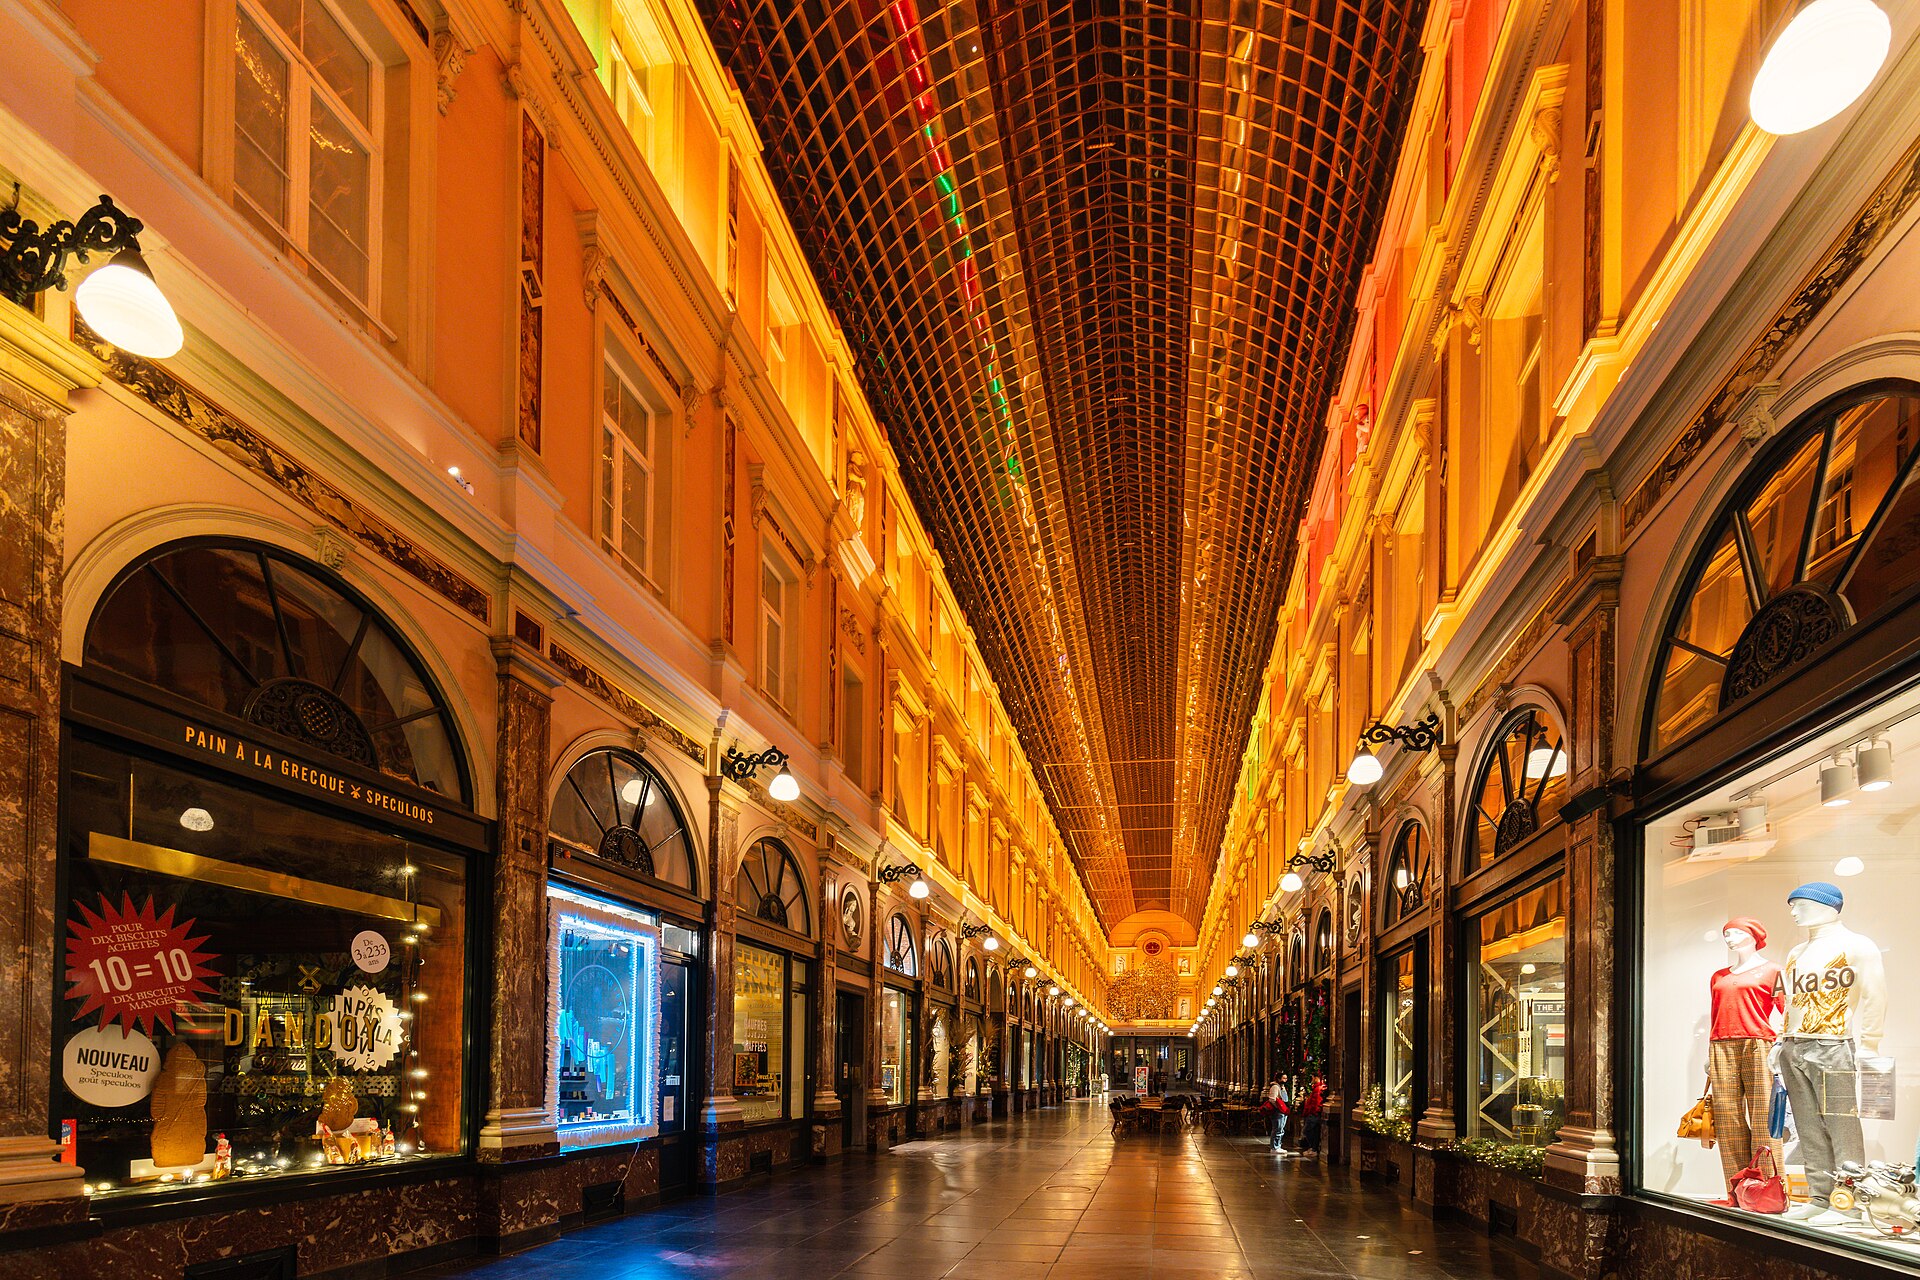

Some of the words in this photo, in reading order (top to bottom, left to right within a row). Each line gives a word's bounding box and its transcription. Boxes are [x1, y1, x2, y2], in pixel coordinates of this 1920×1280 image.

[185, 725, 227, 755] PAIN
[235, 741, 245, 761] À
[254, 750, 273, 770] LA
[281, 759, 346, 795] GRECQUE
[366, 789, 434, 825] SPECULOOS
[111, 922, 144, 934] POUR
[91, 936, 115, 946] DIX
[116, 929, 168, 943] BISCUITS
[363, 939, 374, 947] De
[354, 949, 362, 961] 3
[366, 943, 387, 958] 233
[112, 994, 134, 1005] DIX
[136, 985, 187, 1000] BISCUITS
[260, 990, 353, 1014] MAISON
[224, 1006, 379, 1053] DANDOY
[77, 1047, 150, 1073] NOUVEAU
[79, 1075, 99, 1085] goût
[101, 1079, 142, 1089] speculoos
[90, 1067, 134, 1080] Speculoos
